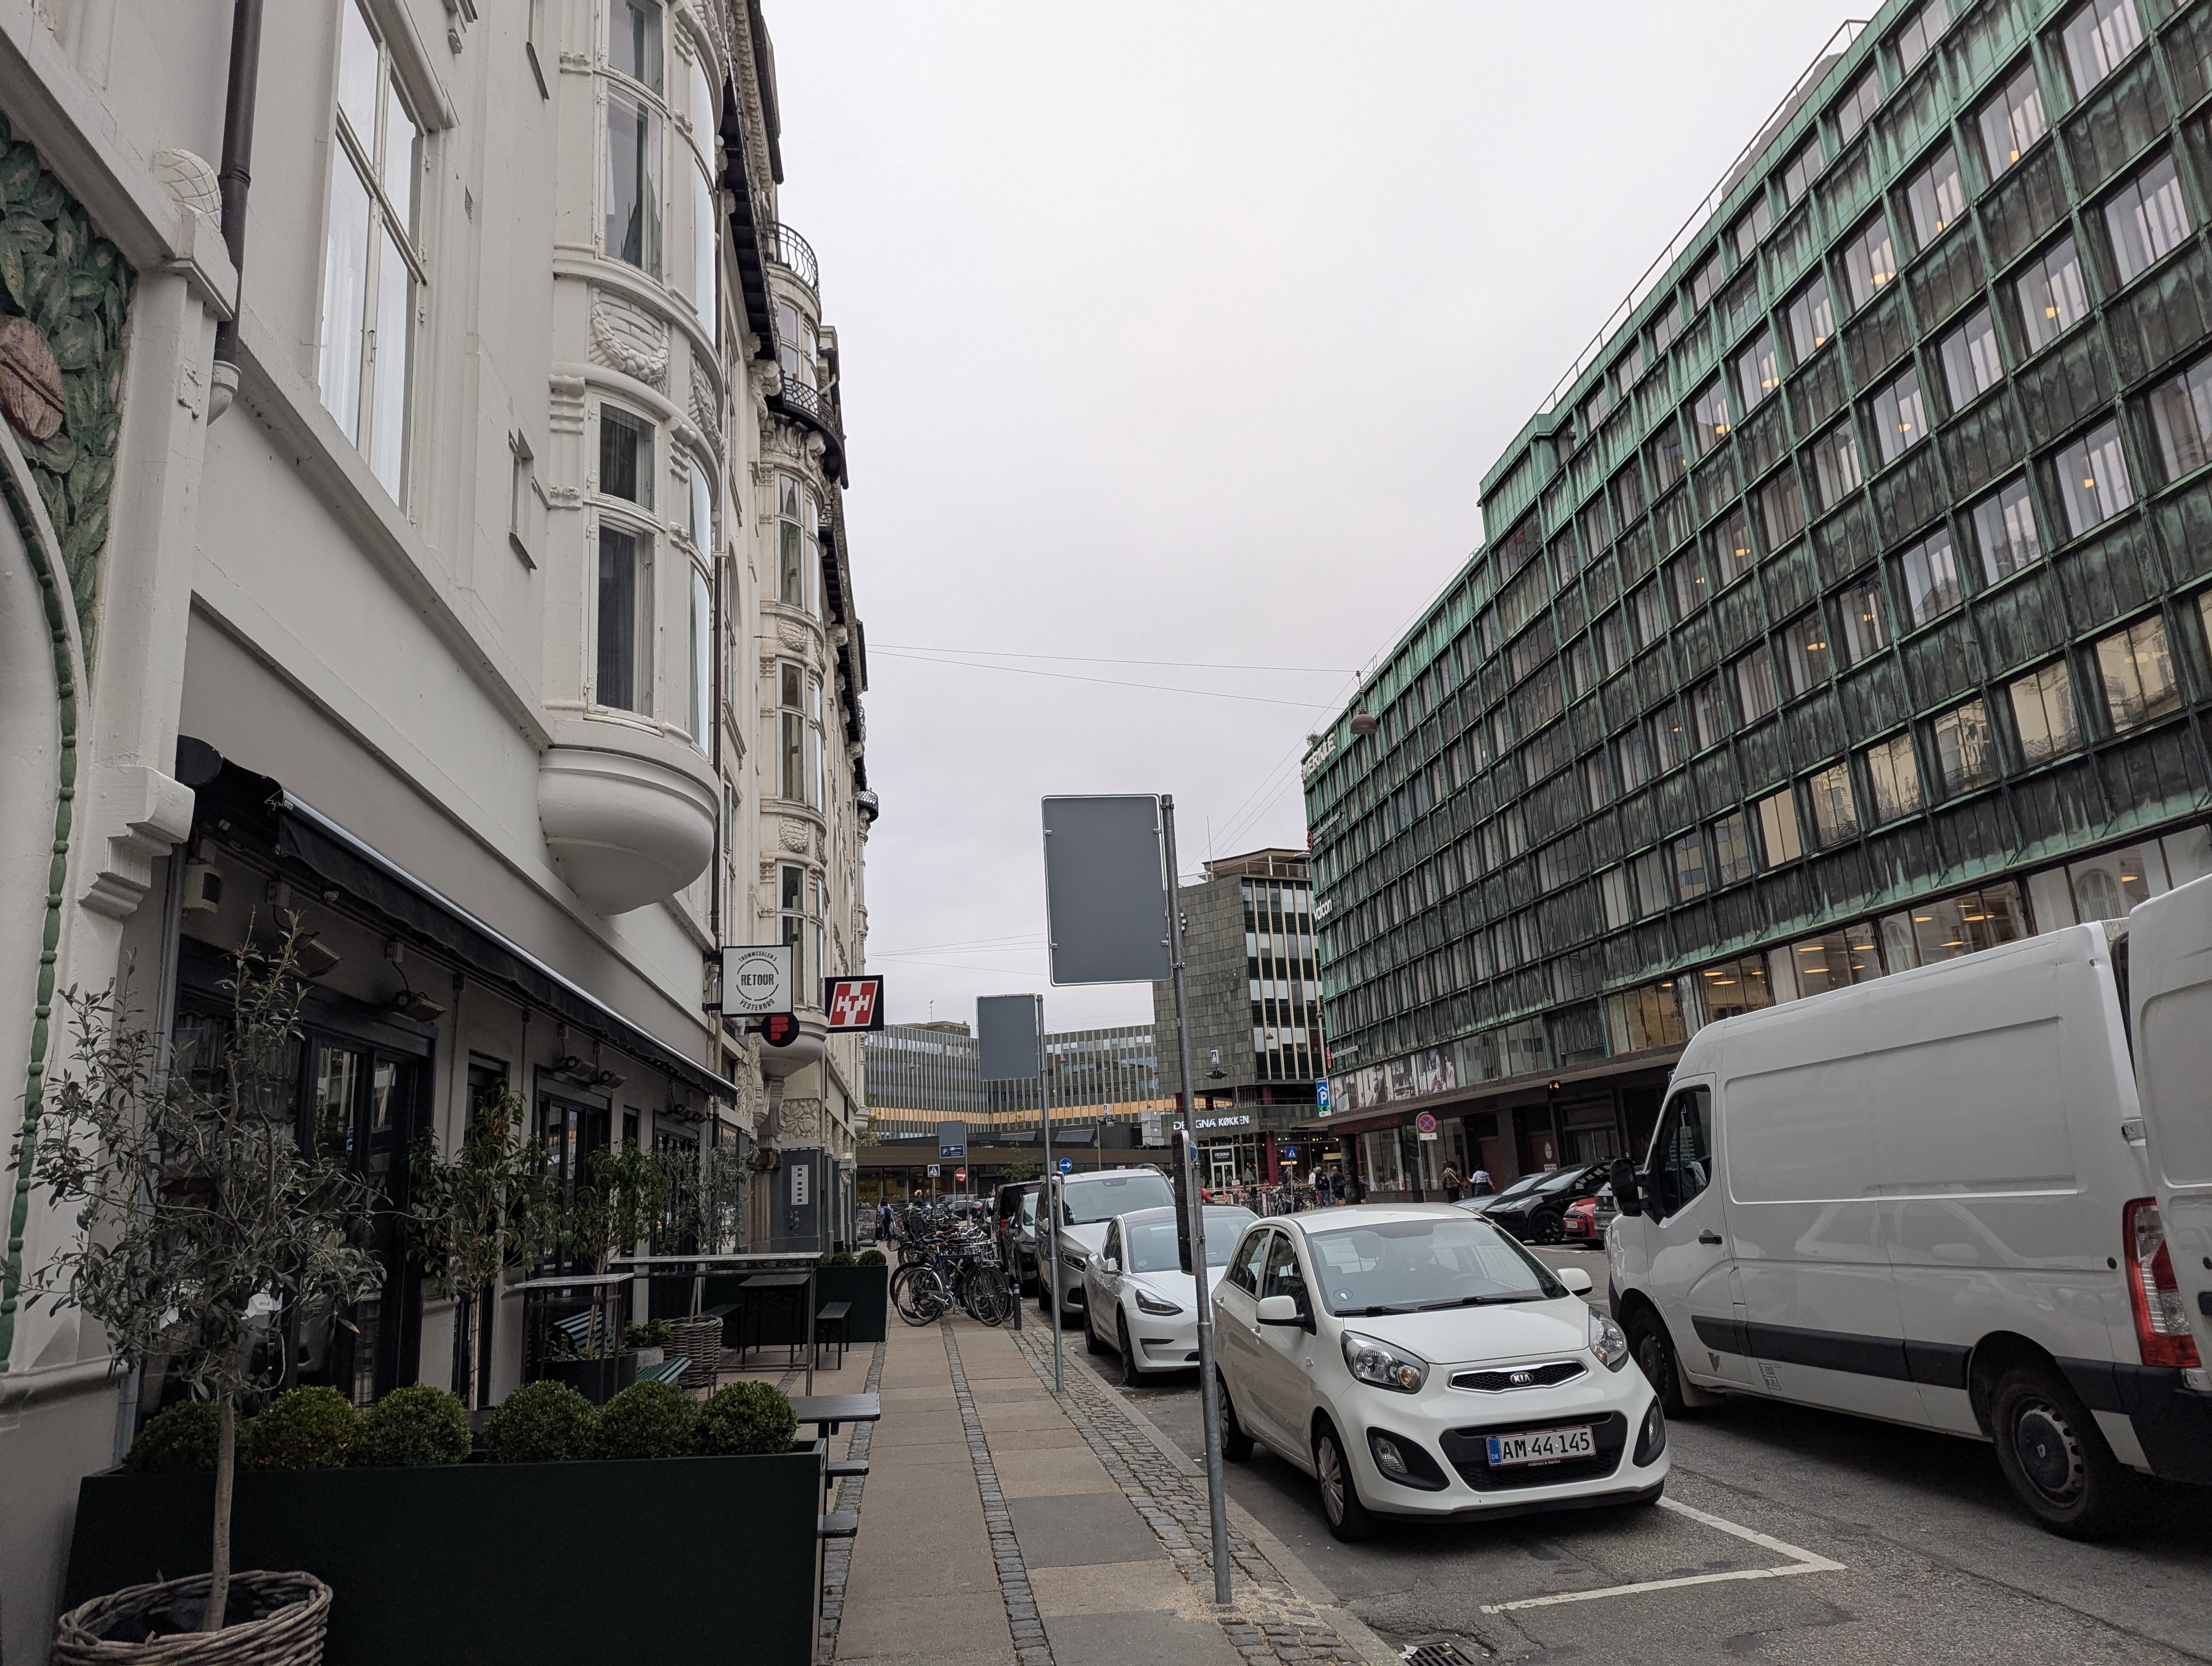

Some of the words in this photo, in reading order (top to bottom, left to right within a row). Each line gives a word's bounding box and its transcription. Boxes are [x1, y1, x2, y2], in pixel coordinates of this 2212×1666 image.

[1302, 733, 1336, 780] MERKLE
[1313, 898, 1333, 922] valcon
[738, 951, 774, 962] TROMMESALEN
[741, 973, 774, 986] RETOUR
[739, 998, 775, 1011] VESTERBRO
[836, 994, 871, 1013] HTH
[1320, 1091, 1328, 1105] P
[1173, 1118, 1217, 1130] DEGNA
[1218, 1115, 1250, 1127] KØKKEN
[1513, 1374, 1531, 1383] KIA
[1503, 1439, 1527, 1459] AM
[1531, 1436, 1553, 1456] 44
[1558, 1432, 1590, 1453] 145
